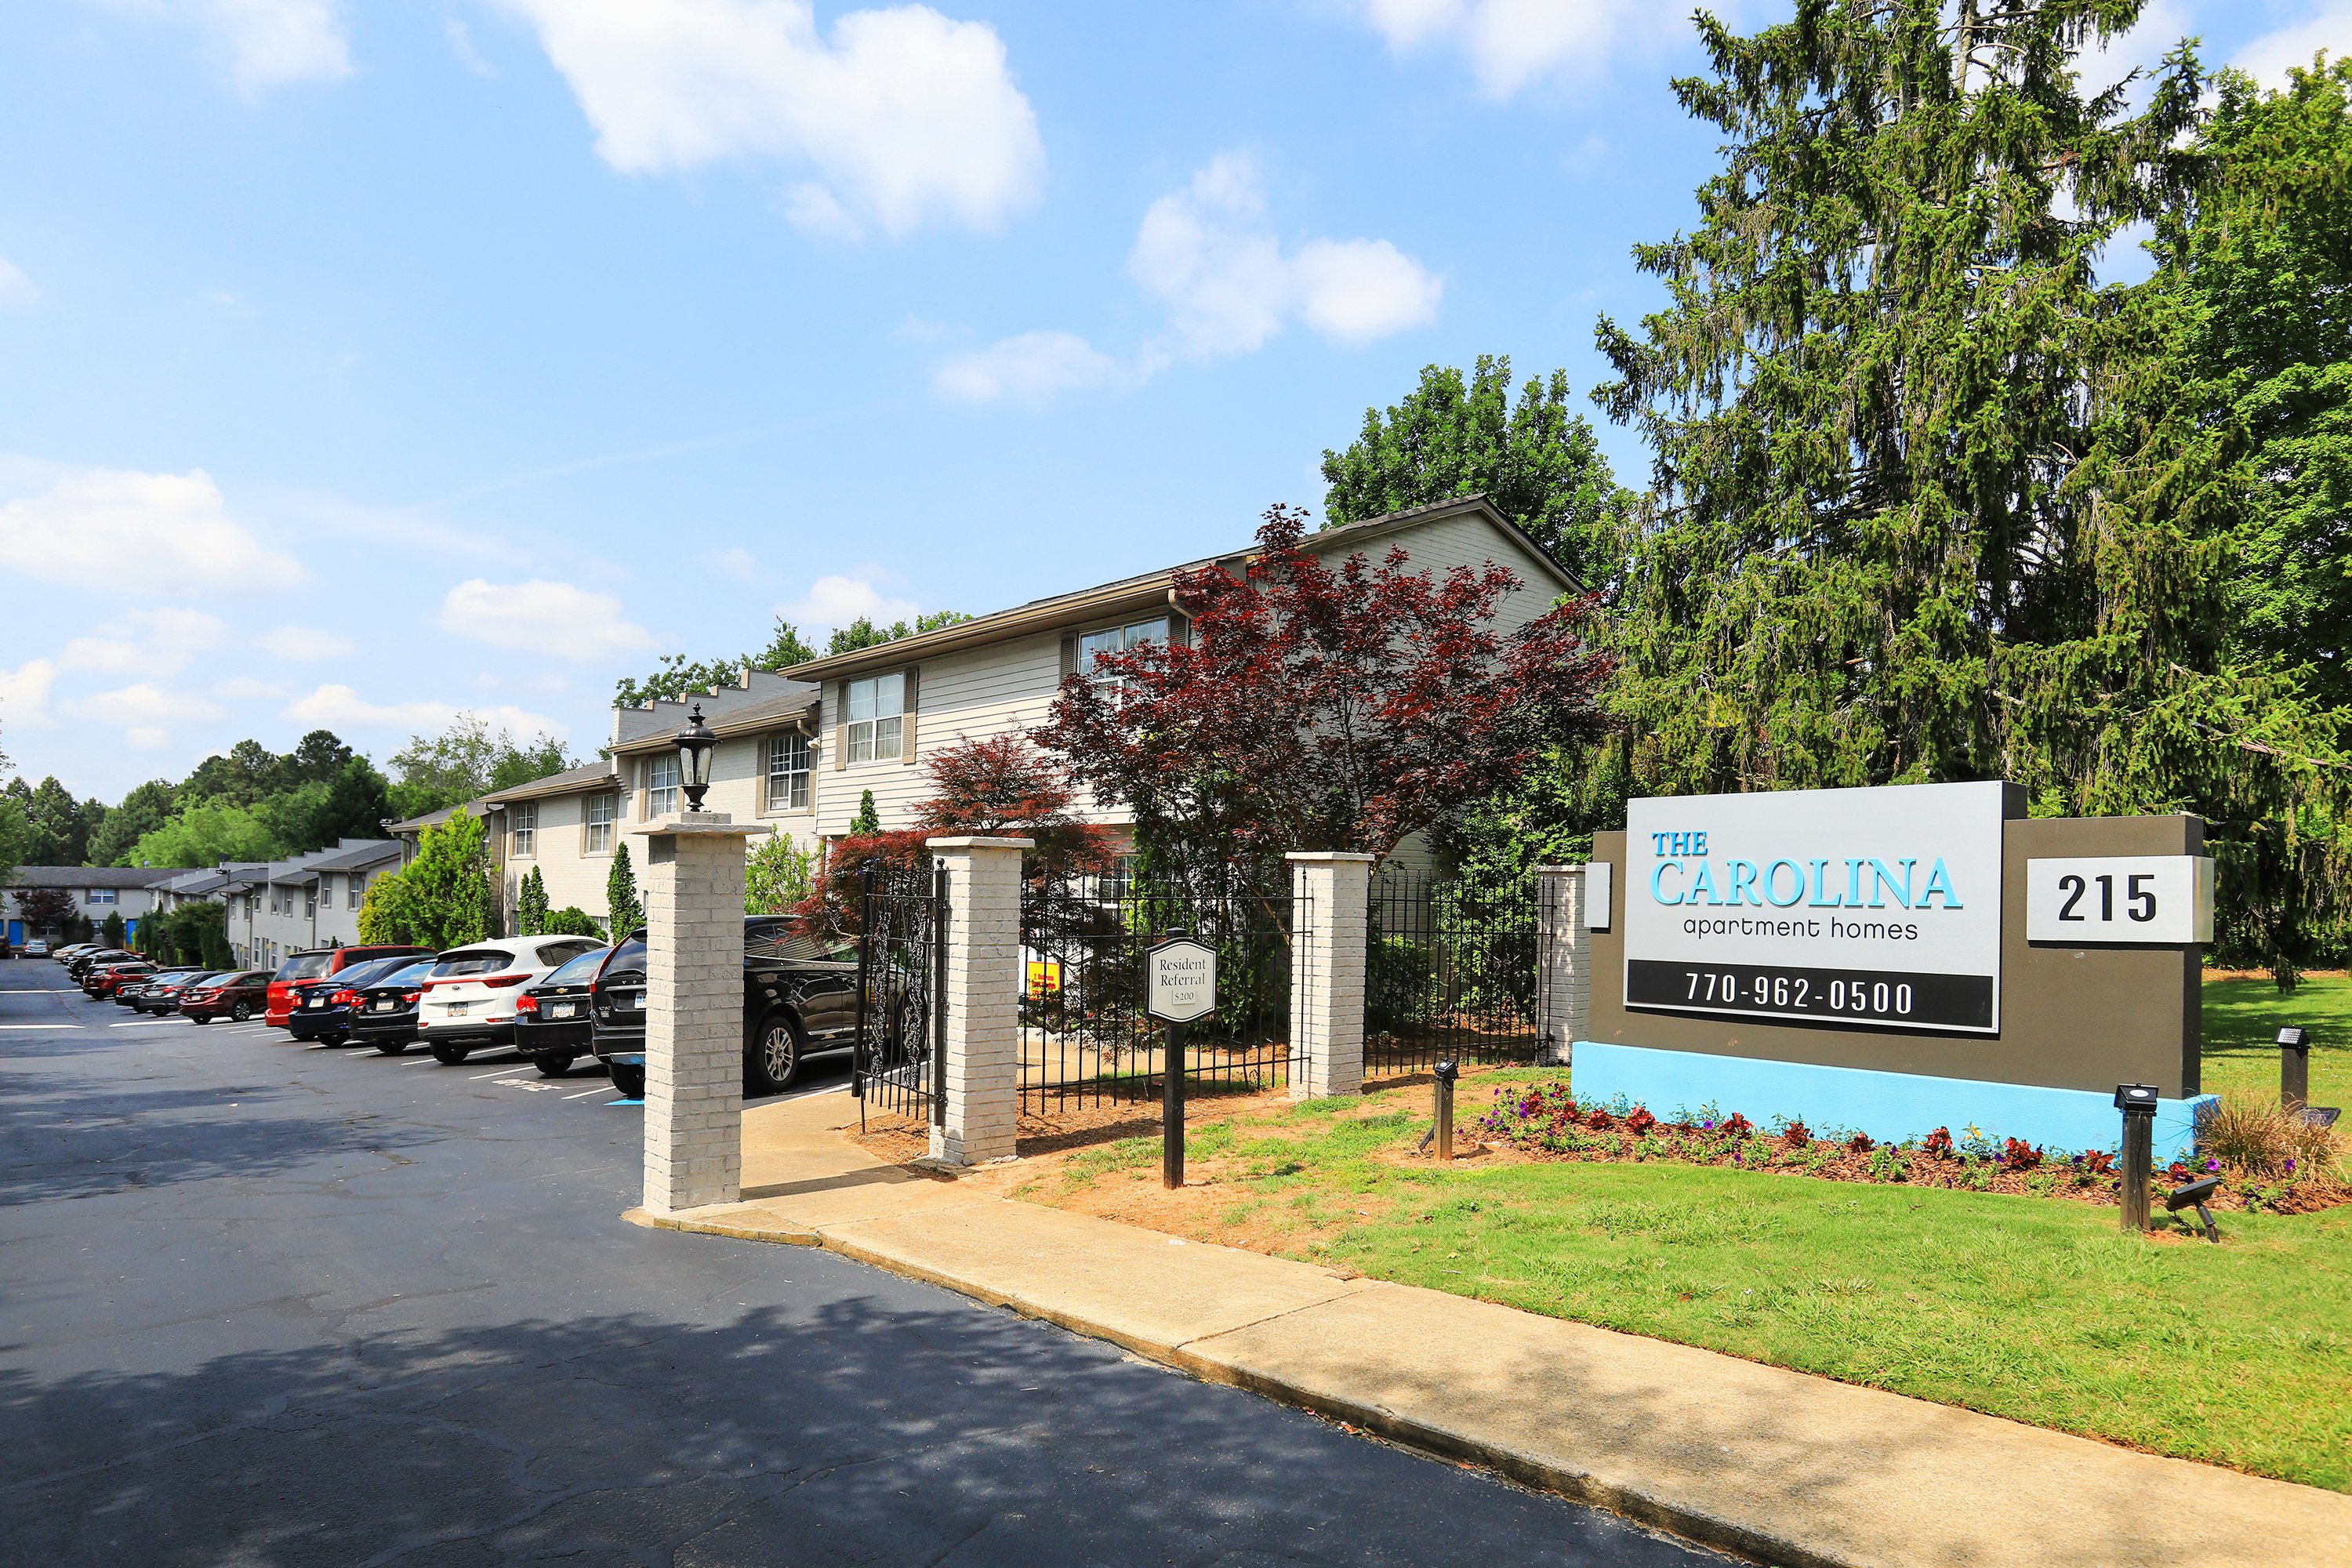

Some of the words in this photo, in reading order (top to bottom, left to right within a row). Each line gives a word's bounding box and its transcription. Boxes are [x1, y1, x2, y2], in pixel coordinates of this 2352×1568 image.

[1652, 831, 1708, 856] THE
[1650, 856, 1964, 909] CAROLINA
[2059, 874, 2157, 922] 215
[1683, 917, 1820, 939] apartment
[1831, 916, 1918, 940] homes
[1160, 957, 1206, 971] Resident
[1160, 973, 1205, 986] Referral
[1686, 972, 1912, 1014] 770-962-0500
